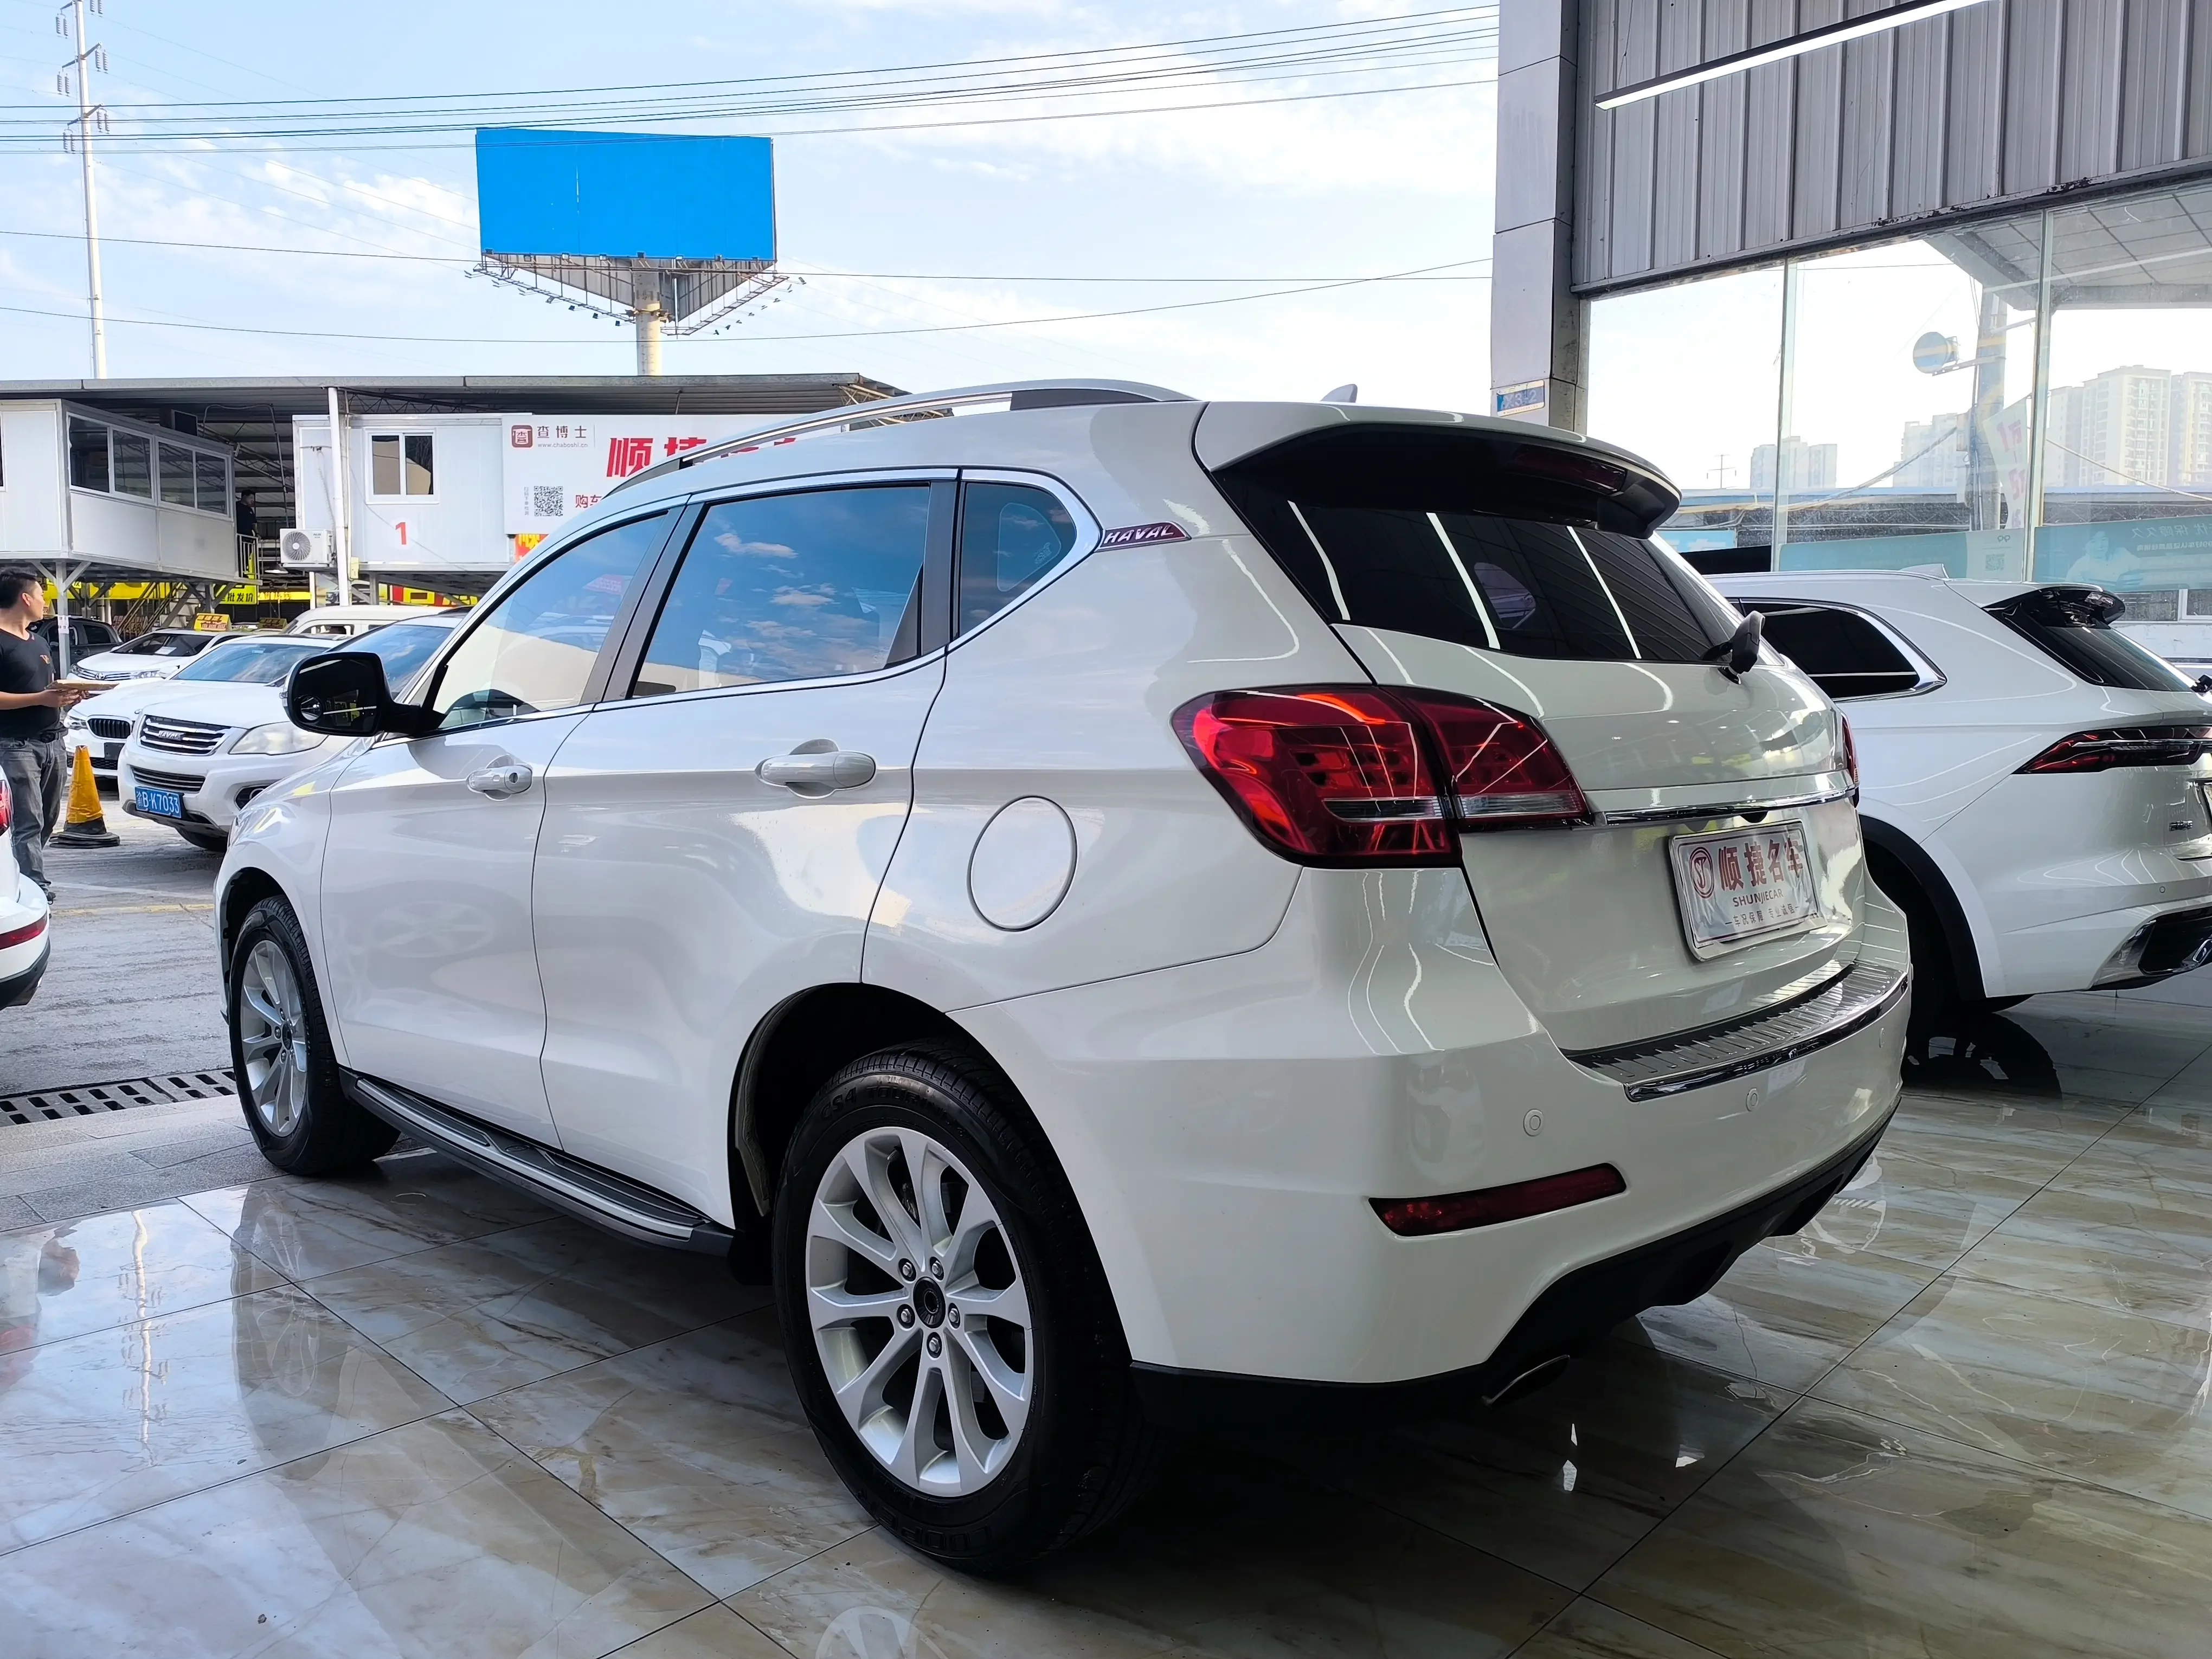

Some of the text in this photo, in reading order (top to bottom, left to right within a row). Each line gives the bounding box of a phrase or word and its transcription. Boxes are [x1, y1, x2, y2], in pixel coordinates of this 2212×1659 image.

[537, 426, 587, 439] 查博士
[395, 522, 407, 545] 1
[1103, 525, 1174, 544] HAVAL
[222, 592, 253, 602] 批发价
[1718, 837, 1803, 891] 顺捷名车
[1732, 888, 1784, 907] SHUNJIECAR
